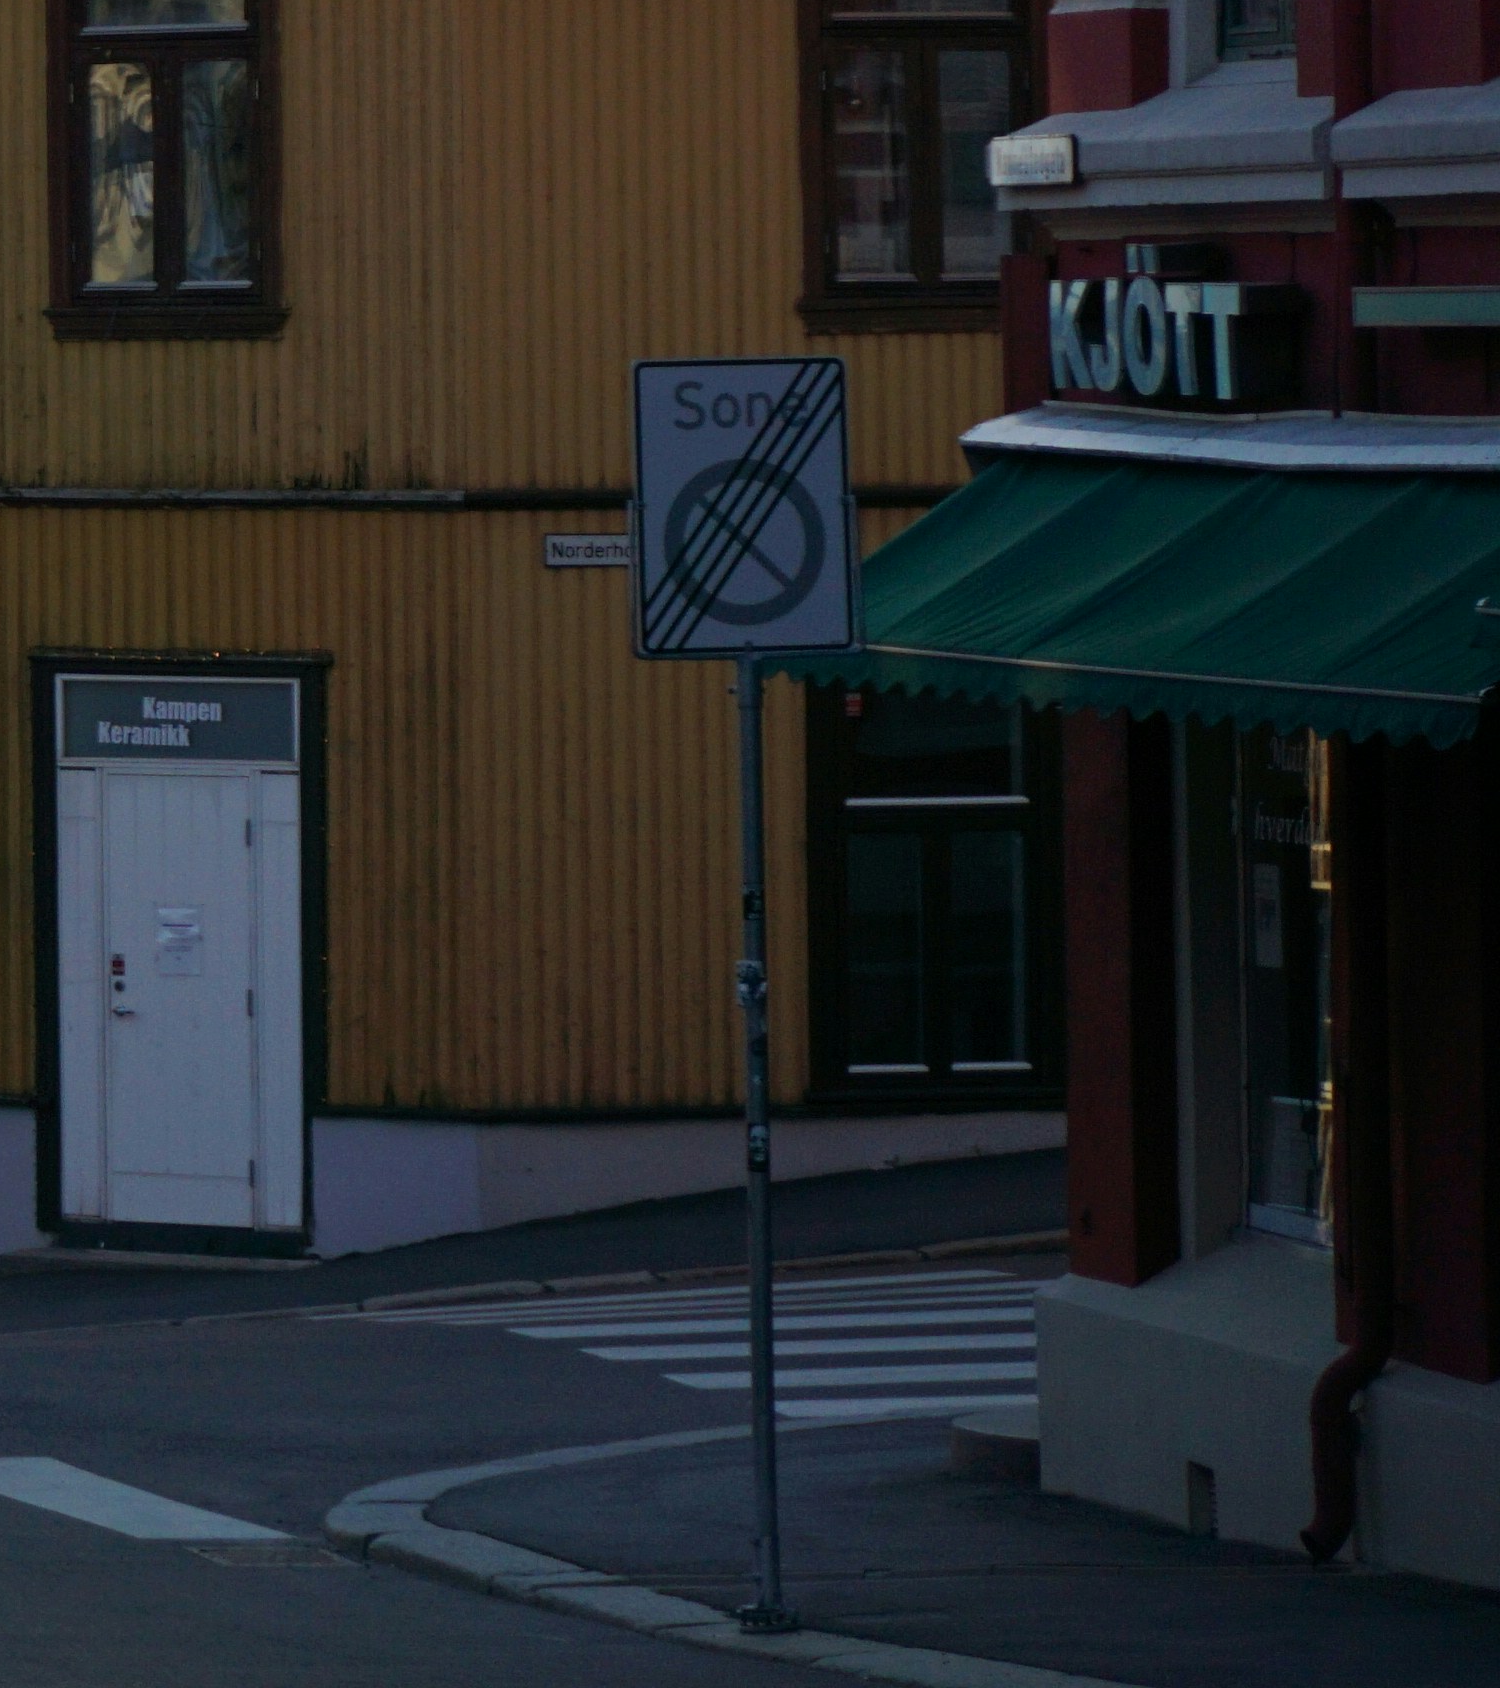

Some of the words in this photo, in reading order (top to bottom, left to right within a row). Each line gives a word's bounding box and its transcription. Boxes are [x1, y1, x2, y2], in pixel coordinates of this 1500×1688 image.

[1049, 243, 1240, 400] KJÖTT
[674, 381, 808, 430] Sone
[142, 697, 222, 723] Kampen
[98, 721, 190, 747] Keramikk
